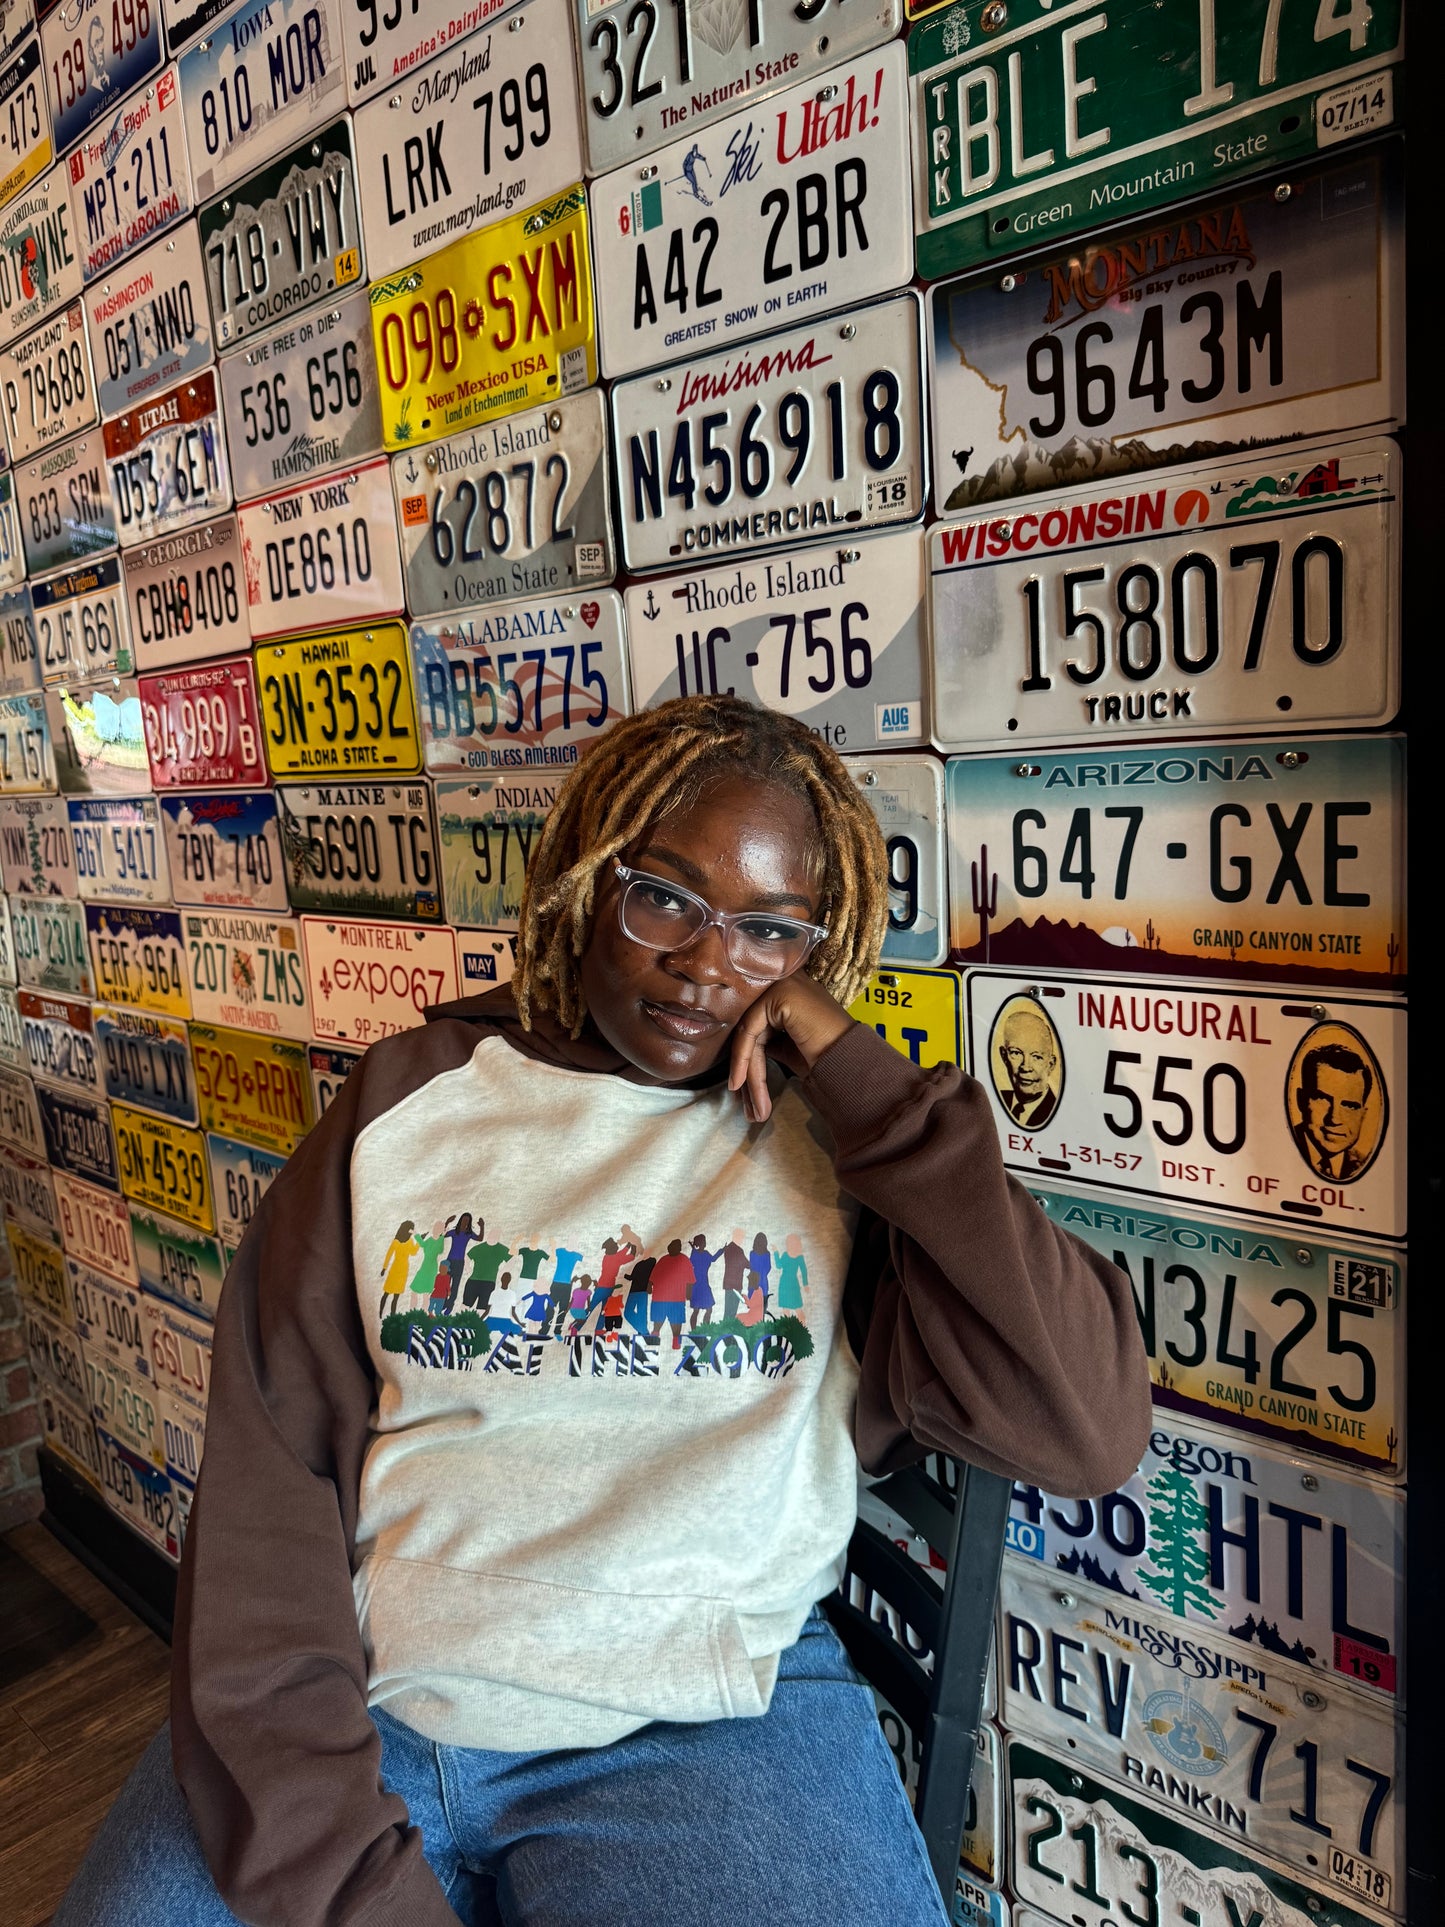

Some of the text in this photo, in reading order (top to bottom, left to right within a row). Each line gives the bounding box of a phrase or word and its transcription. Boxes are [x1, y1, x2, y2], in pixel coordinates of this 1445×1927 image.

[112, 0, 151, 60] 498
[392, 27, 447, 77] America's
[53, 37, 87, 117] 139
[201, 64, 251, 155] 810
[267, 8, 326, 111] MOR
[354, 59, 377, 91] JUL
[411, 35, 492, 114] Maryland
[590, 0, 693, 119] 321
[661, 52, 799, 130] The Natural State
[957, 12, 1112, 198] BLE
[1321, 87, 1386, 129] 07/14
[89, 103, 151, 166] First Flight
[382, 62, 551, 226] LRK 799
[719, 68, 884, 198] Ski Utah!
[84, 126, 172, 245] MPT-211
[1013, 134, 1268, 234] Green Mountain State
[88, 192, 180, 273] NORTH CAROLINA
[412, 178, 527, 249] www.maryland.gov
[338, 255, 353, 276] 14
[634, 157, 869, 330] A42 2BR
[1042, 206, 1254, 323] MONTANA
[94, 272, 154, 324] WASHINGTON
[248, 272, 322, 325] COLORADO
[1118, 260, 1240, 304] Big Sky Country
[11, 302, 41, 330] SUNSHINE
[222, 320, 230, 337] 6
[251, 314, 334, 366] LIVE FREE OR DIE
[664, 281, 827, 347] GREATEST SNOW ON EARTH
[15, 324, 62, 365] MARYLAND
[1026, 270, 1283, 439] 9643M
[22, 340, 86, 427] 79688
[127, 360, 182, 398] EVERGREEN STATE
[241, 340, 362, 447] 536 656
[426, 354, 549, 413] New Mexico USA
[676, 338, 833, 415] Louisiana
[37, 417, 66, 442] TRUCK
[138, 399, 180, 435] UTAH
[445, 384, 528, 425] Land of Enchantment
[40, 446, 77, 476] MISSOURI
[272, 437, 341, 480] HAMPSHIRE
[436, 412, 551, 475] Rhode Island
[630, 369, 902, 523] N456918
[273, 482, 350, 525] NEW YORK
[405, 499, 422, 515] SEP
[873, 475, 908, 489] LOUISIANA
[876, 482, 907, 505] 18
[29, 488, 62, 543] 833
[433, 452, 575, 567] 62872
[684, 498, 845, 550] COMMERCIAL
[941, 489, 1166, 565] WISCONSIN
[147, 532, 214, 567] GEORGIA
[266, 517, 372, 602] DE8610
[580, 548, 600, 562] SEP
[455, 562, 558, 602] Ocean State
[685, 550, 846, 614] Rhode Island
[455, 608, 567, 648] ALABAMA
[1020, 534, 1345, 692] 158070
[302, 641, 350, 664] HAWAII
[266, 660, 409, 744] 3N-3532
[425, 641, 609, 738] BB55775
[1084, 691, 1192, 722] TRUCK
[182, 695, 229, 760] 989
[881, 708, 910, 727] AUG
[301, 746, 379, 767] ALOHA STATE
[468, 745, 578, 768] GOD BLESS AMERICA
[1044, 756, 1275, 791] ARIZONA
[317, 788, 423, 806] MAINE AUG
[42, 828, 69, 868] 270
[73, 826, 157, 880] BGY 5417
[228, 834, 272, 884] 740
[307, 815, 432, 886] 5690 TG
[1013, 802, 1372, 907] 647-GXE
[206, 917, 273, 943] OKLAHOMA
[340, 926, 413, 951] MONTREAL
[1193, 928, 1361, 956] GRAND CANYON STATE
[143, 944, 182, 997] 964
[190, 941, 305, 1007] 207 ZMS
[467, 957, 493, 973] MAY
[42, 1002, 69, 1021] UTAH
[316, 1018, 336, 1031] 1967
[864, 988, 914, 1009] 1992
[1077, 992, 1272, 1045] INAUGURAL
[118, 1012, 163, 1038] NEVADA
[1103, 1050, 1247, 1155] 550
[1008, 1134, 1366, 1213] EX. 1-31-57 DIST. OF COL.
[1063, 1205, 1285, 1268] ARIZONA
[1351, 1271, 1380, 1301] 21
[484, 1331, 554, 1377] AT
[564, 1333, 662, 1378] THE
[674, 1333, 798, 1380] ZOO
[1206, 1380, 1367, 1441] GRAND CANYON STATE
[1208, 1484, 1391, 1654] HTL
[1105, 1609, 1267, 1692] MISSISSIPPI
[1349, 1657, 1382, 1682] 19
[1229, 1682, 1263, 1704] America's
[1009, 1612, 1134, 1740] REV
[1236, 1708, 1392, 1858] 717
[1123, 1753, 1249, 1833] RANKIN
[955, 1879, 988, 1911] APR
[1332, 1850, 1355, 1881] 04
[1363, 1869, 1386, 1899] 18
